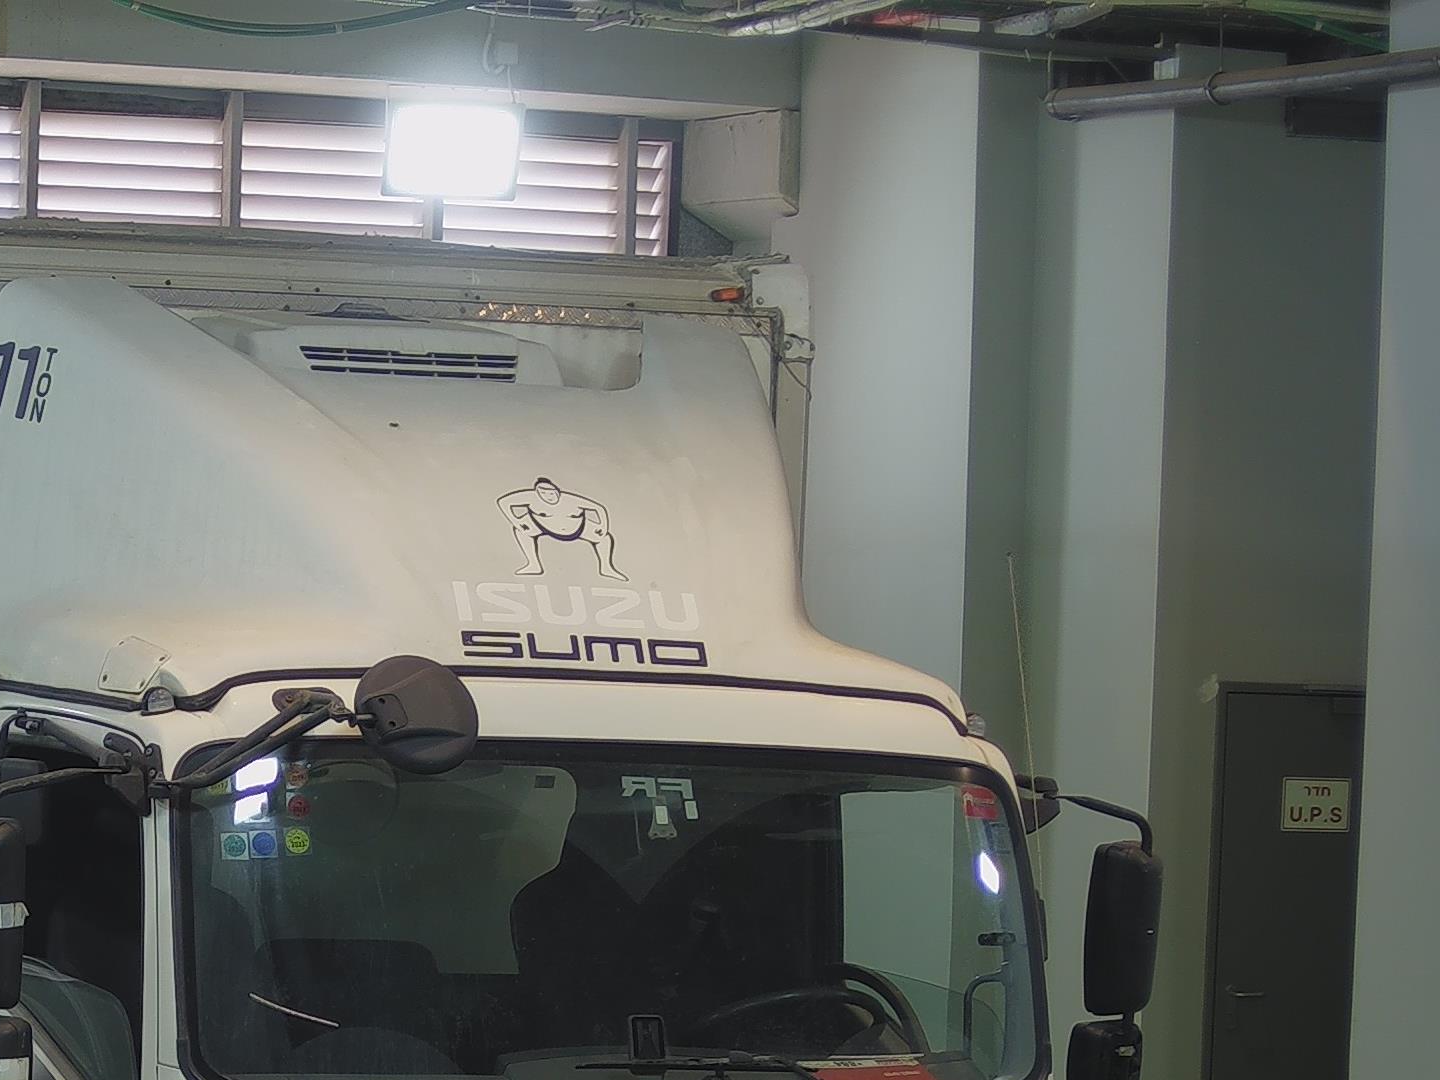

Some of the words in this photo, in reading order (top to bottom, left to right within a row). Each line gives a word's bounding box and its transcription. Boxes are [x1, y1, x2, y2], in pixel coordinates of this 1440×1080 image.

[29, 347, 58, 423] TON
[452, 580, 700, 631] ISUZU
[1304, 786, 1331, 797] חדר
[1290, 806, 1343, 823] U.P.S
